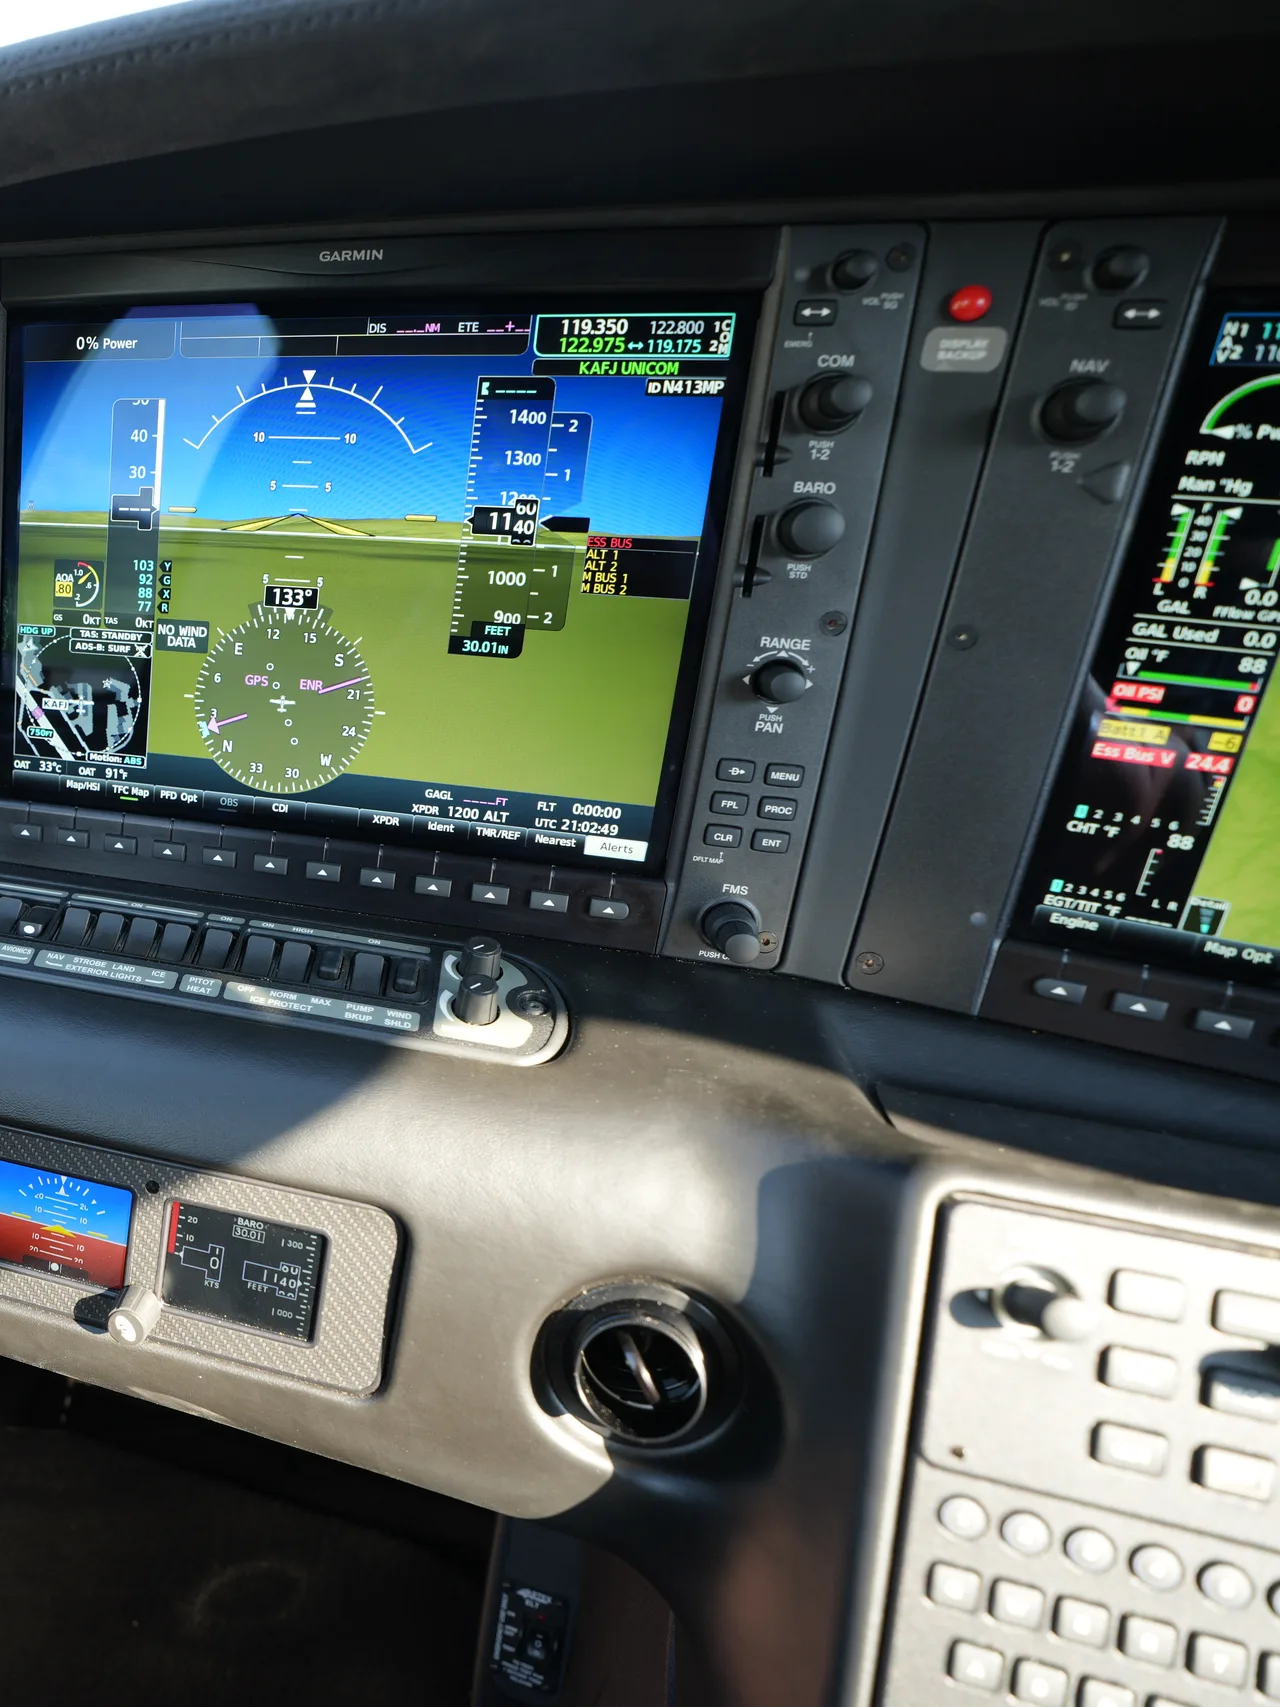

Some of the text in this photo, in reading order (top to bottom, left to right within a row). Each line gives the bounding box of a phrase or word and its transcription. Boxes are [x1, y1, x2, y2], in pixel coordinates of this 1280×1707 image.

[319, 249, 383, 262] GARMIN
[369, 322, 387, 333] DIS
[458, 322, 479, 332] ETE
[561, 319, 704, 335] 119.350 122.800
[76, 336, 137, 350] 0% Power
[559, 337, 701, 353] 122.975 119.175
[939, 339, 990, 349] DISPLAY
[817, 355, 855, 368] COM
[937, 350, 988, 361] BACKUP
[579, 362, 679, 376] KAFJ UNICOM
[1070, 360, 1110, 372] NAV
[663, 380, 724, 394] N413MP
[509, 409, 546, 425] 1400
[130, 430, 148, 443] 40
[505, 450, 541, 466] 1300
[1185, 450, 1226, 466] RPM
[129, 466, 146, 479] 30
[793, 481, 836, 494] BARO
[1178, 476, 1216, 492] Man
[587, 536, 632, 548] ESS BUS
[586, 549, 608, 559] ALT
[134, 560, 154, 571] 103
[584, 561, 606, 570] ALT
[787, 564, 811, 572] PUSH
[55, 573, 74, 582] AOA
[139, 574, 153, 584] 92
[488, 570, 526, 586] 1000
[595, 573, 617, 583] BUS
[789, 571, 808, 579] STD
[138, 588, 152, 598] 88
[593, 584, 615, 594] BUS
[138, 601, 151, 612] 77
[494, 610, 520, 624] 900
[20, 626, 38, 634] HDG
[80, 630, 142, 641] TAS: STANDBY
[158, 624, 207, 637] NO WIND
[485, 625, 511, 636] FEET
[1132, 622, 1220, 644] GAL Used
[75, 643, 130, 652] ADS-B: SURF
[167, 636, 196, 648] DATA
[760, 636, 811, 650] RANGE
[1238, 657, 1267, 674] 88
[245, 675, 269, 687] GPS
[300, 679, 323, 691] ENR
[759, 714, 783, 722] PUSH
[755, 721, 783, 734] PAN
[90, 752, 142, 765] Motion: ABS
[1185, 755, 1231, 772] 24.4
[14, 760, 96, 777] OAT OAT
[771, 772, 800, 782] MENU
[67, 780, 100, 792] Map/HSI
[112, 784, 149, 799] TFC Map
[161, 790, 198, 804] PFD Opt
[425, 789, 453, 801] GAGL
[220, 797, 238, 807] OBS
[272, 802, 289, 813] CDI
[721, 800, 738, 809] FPL
[412, 803, 509, 823] XPDR 1200 ALT
[537, 801, 622, 820] FLT 0:00:00
[765, 805, 792, 815] PROC
[372, 814, 399, 826] XPDR
[428, 820, 455, 833] Ident
[535, 817, 619, 836] UTC 21:02:49
[476, 827, 521, 841] TMR/REF
[714, 833, 733, 842] CLR
[1066, 821, 1195, 851] CHT 88
[535, 834, 576, 848] Nearest
[762, 838, 781, 847] ENT
[600, 841, 634, 854] Alerts
[722, 884, 748, 895] FMS
[1049, 913, 1099, 931] Engine
[2, 945, 31, 955] AVIONICS
[699, 950, 720, 959] PUSH
[1204, 941, 1274, 964] Map Opt
[47, 953, 65, 961] NAV
[73, 957, 107, 968] STROBE
[65, 964, 142, 982] EXTERIOR LIGHTS
[189, 977, 215, 986] PITOT
[187, 985, 212, 994] HEAT
[237, 985, 255, 993] OFF
[270, 990, 297, 1000] NORM
[250, 995, 313, 1012] ICE PROTECT
[311, 998, 332, 1006] MAX
[346, 1003, 375, 1012] PUMP
[345, 1012, 373, 1022] BKUP
[386, 1010, 412, 1020] WIND
[384, 1019, 412, 1028] SHLD
[187, 1216, 198, 1224] 20
[238, 1218, 263, 1229] BARO
[235, 1228, 261, 1241] 30.01
[204, 1280, 219, 1288] KTS
[247, 1282, 268, 1293] FEET
